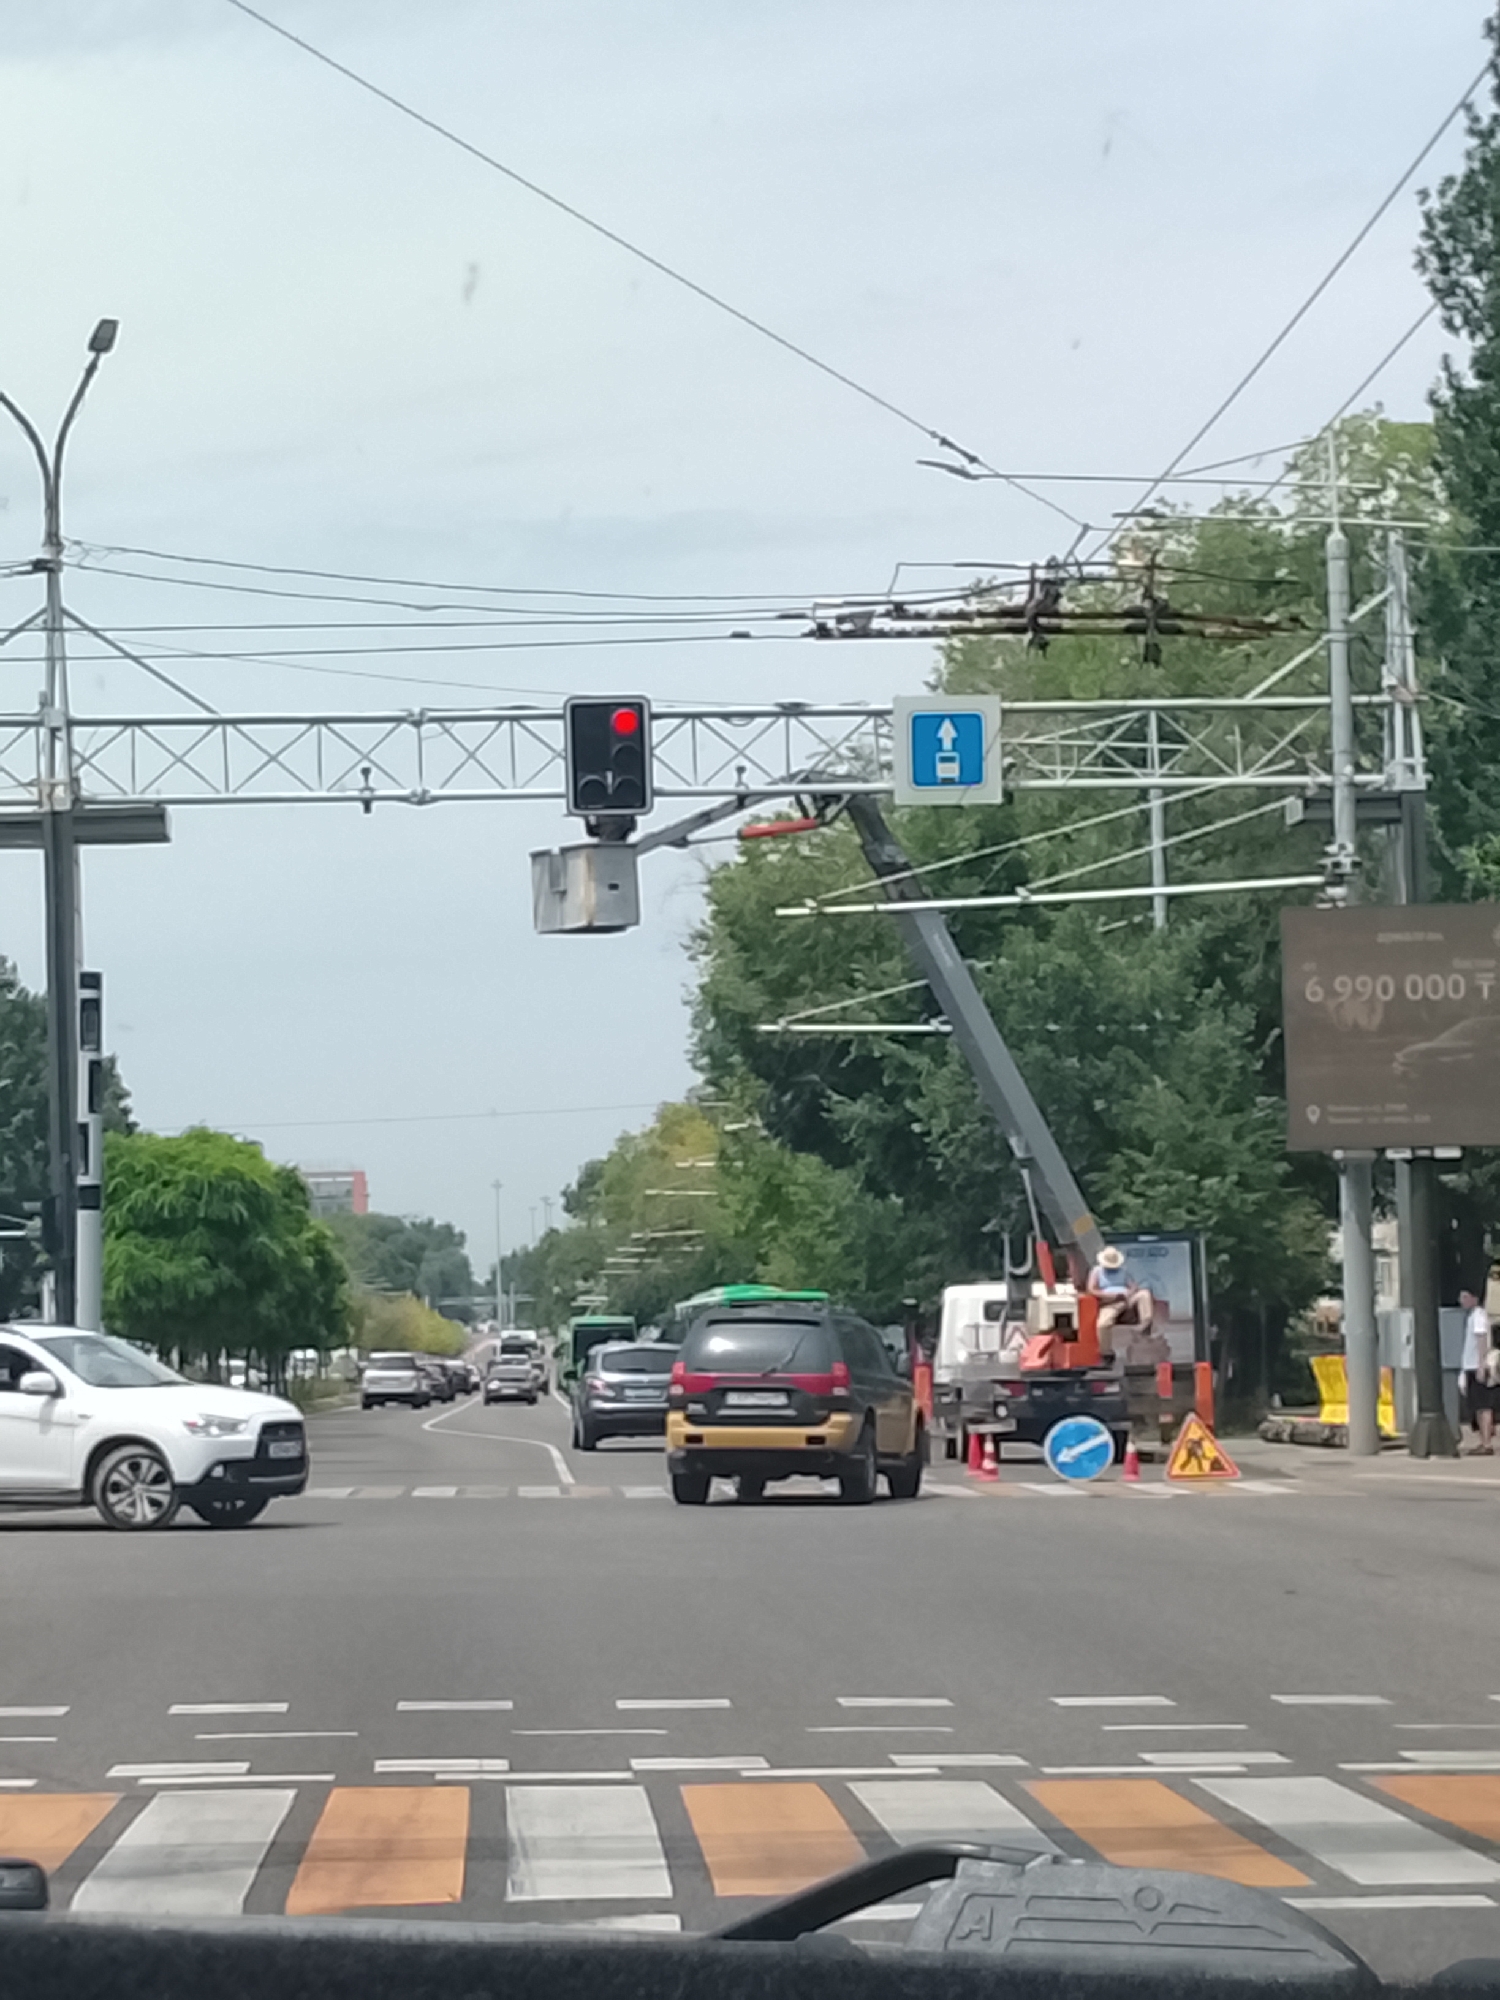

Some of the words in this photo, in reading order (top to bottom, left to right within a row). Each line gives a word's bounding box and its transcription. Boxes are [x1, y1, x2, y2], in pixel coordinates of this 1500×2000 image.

[1305, 975, 1325, 1003] 6
[1333, 974, 1395, 1001] 990
[1405, 973, 1466, 1000] 000
